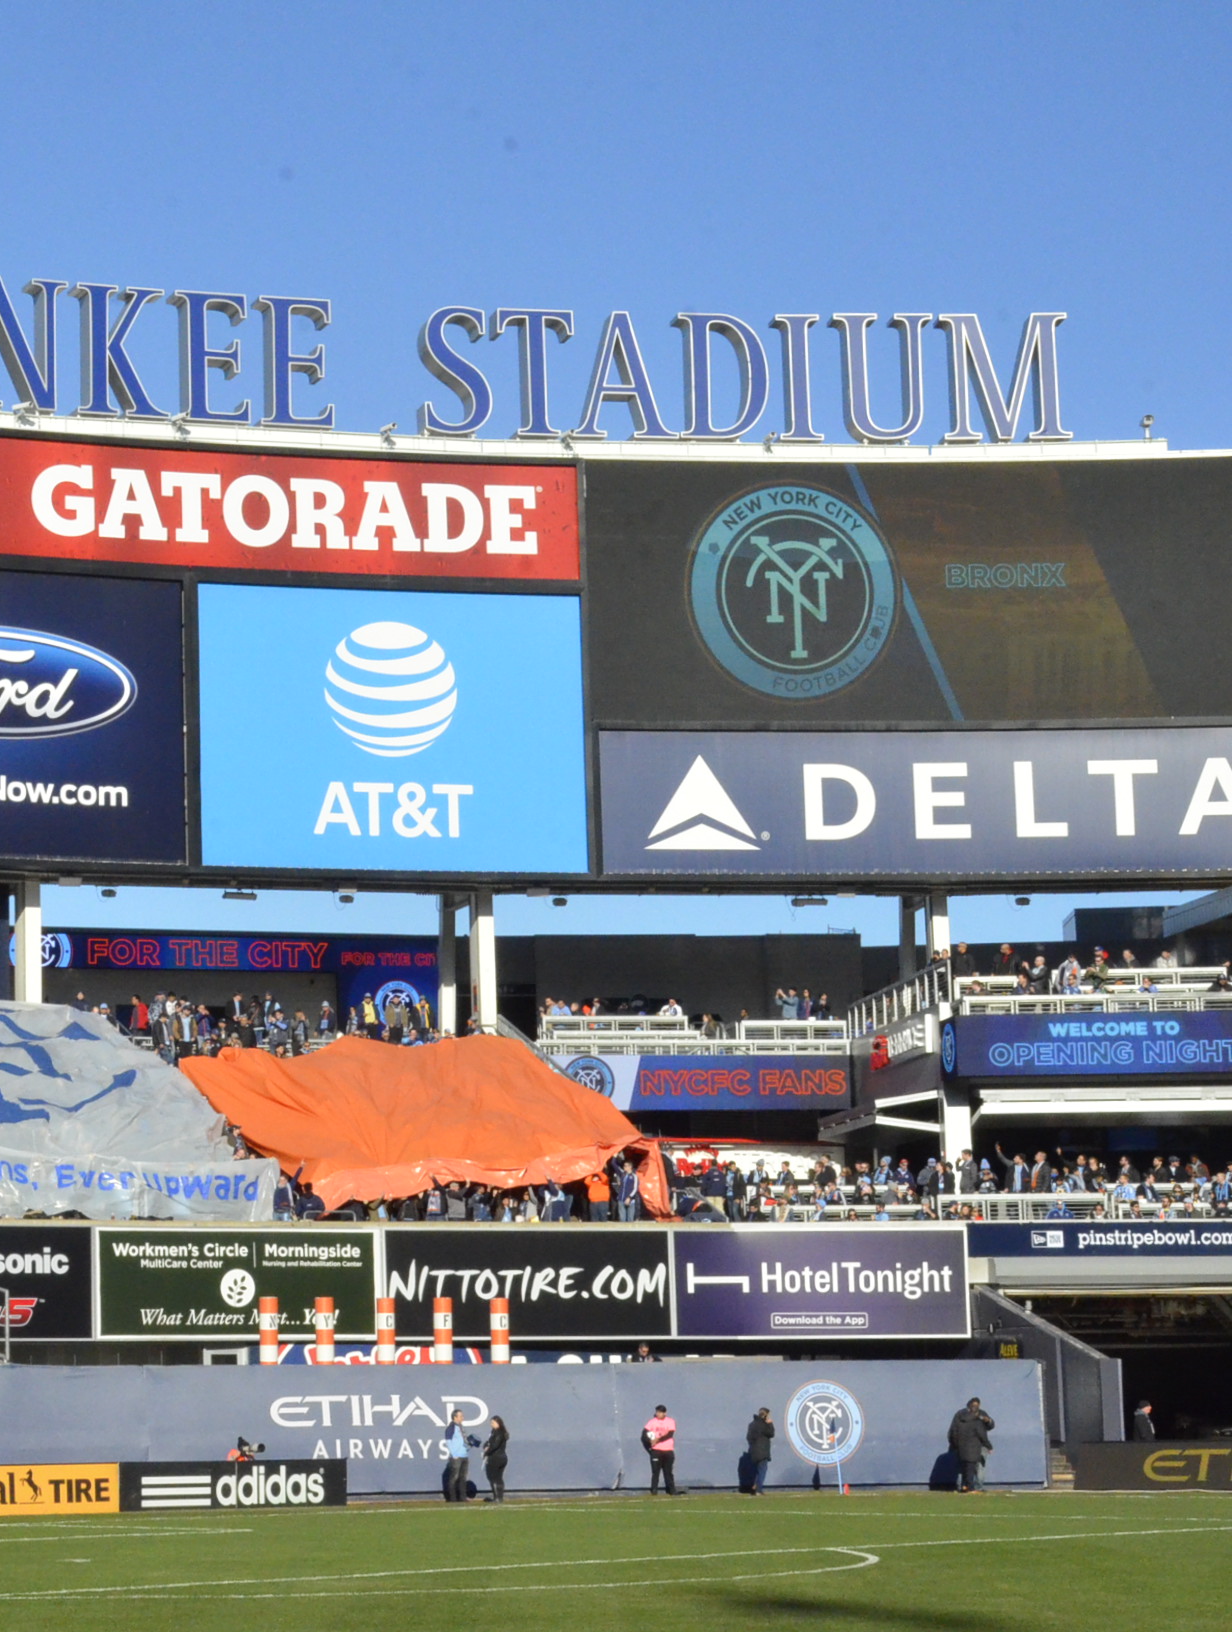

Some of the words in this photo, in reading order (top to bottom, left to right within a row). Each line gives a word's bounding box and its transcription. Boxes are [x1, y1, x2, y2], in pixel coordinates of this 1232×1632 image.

[419, 305, 1073, 443] STADIUM
[31, 463, 539, 556] GATORADE
[722, 495, 764, 532] NEW
[768, 490, 821, 509] YORK
[824, 501, 863, 532] CITY
[945, 562, 1066, 589] BRONX
[772, 655, 867, 692] FOOTBALL
[864, 604, 890, 652] CUB
[313, 781, 474, 839] AT&T
[803, 757, 1232, 841] DELTA
[87, 938, 161, 966] FOR
[170, 939, 238, 967] THE
[248, 941, 328, 968] CITY
[341, 952, 375, 966] FOR
[378, 952, 411, 966] THE
[1048, 1021, 1148, 1037] WELCOME
[1152, 1020, 1180, 1035] TO
[988, 1040, 1134, 1067] OPENING
[640, 1069, 752, 1096] NYCFC
[759, 1069, 847, 1096] FANS
[55, 1164, 136, 1191] Ever
[112, 1242, 199, 1257] Workmen's
[204, 1242, 248, 1257] Circle
[264, 1243, 361, 1260] Morningside
[1077, 1229, 1232, 1249] pinstripebowl.com
[140, 1258, 188, 1269] MultiCare
[190, 1259, 223, 1269] Center
[262, 1260, 286, 1268] Nursing
[389, 1258, 667, 1308] NITTOTIRE.COM
[140, 1308, 183, 1326] What
[186, 1308, 245, 1326] Matters
[774, 1315, 824, 1325] Download
[825, 1315, 842, 1325] the
[844, 1315, 865, 1325] App
[269, 1394, 489, 1427] ETIHAD
[312, 1438, 452, 1460] AIRWAYS
[48, 1477, 110, 1504] TIRE
[216, 1465, 325, 1506] adidas
